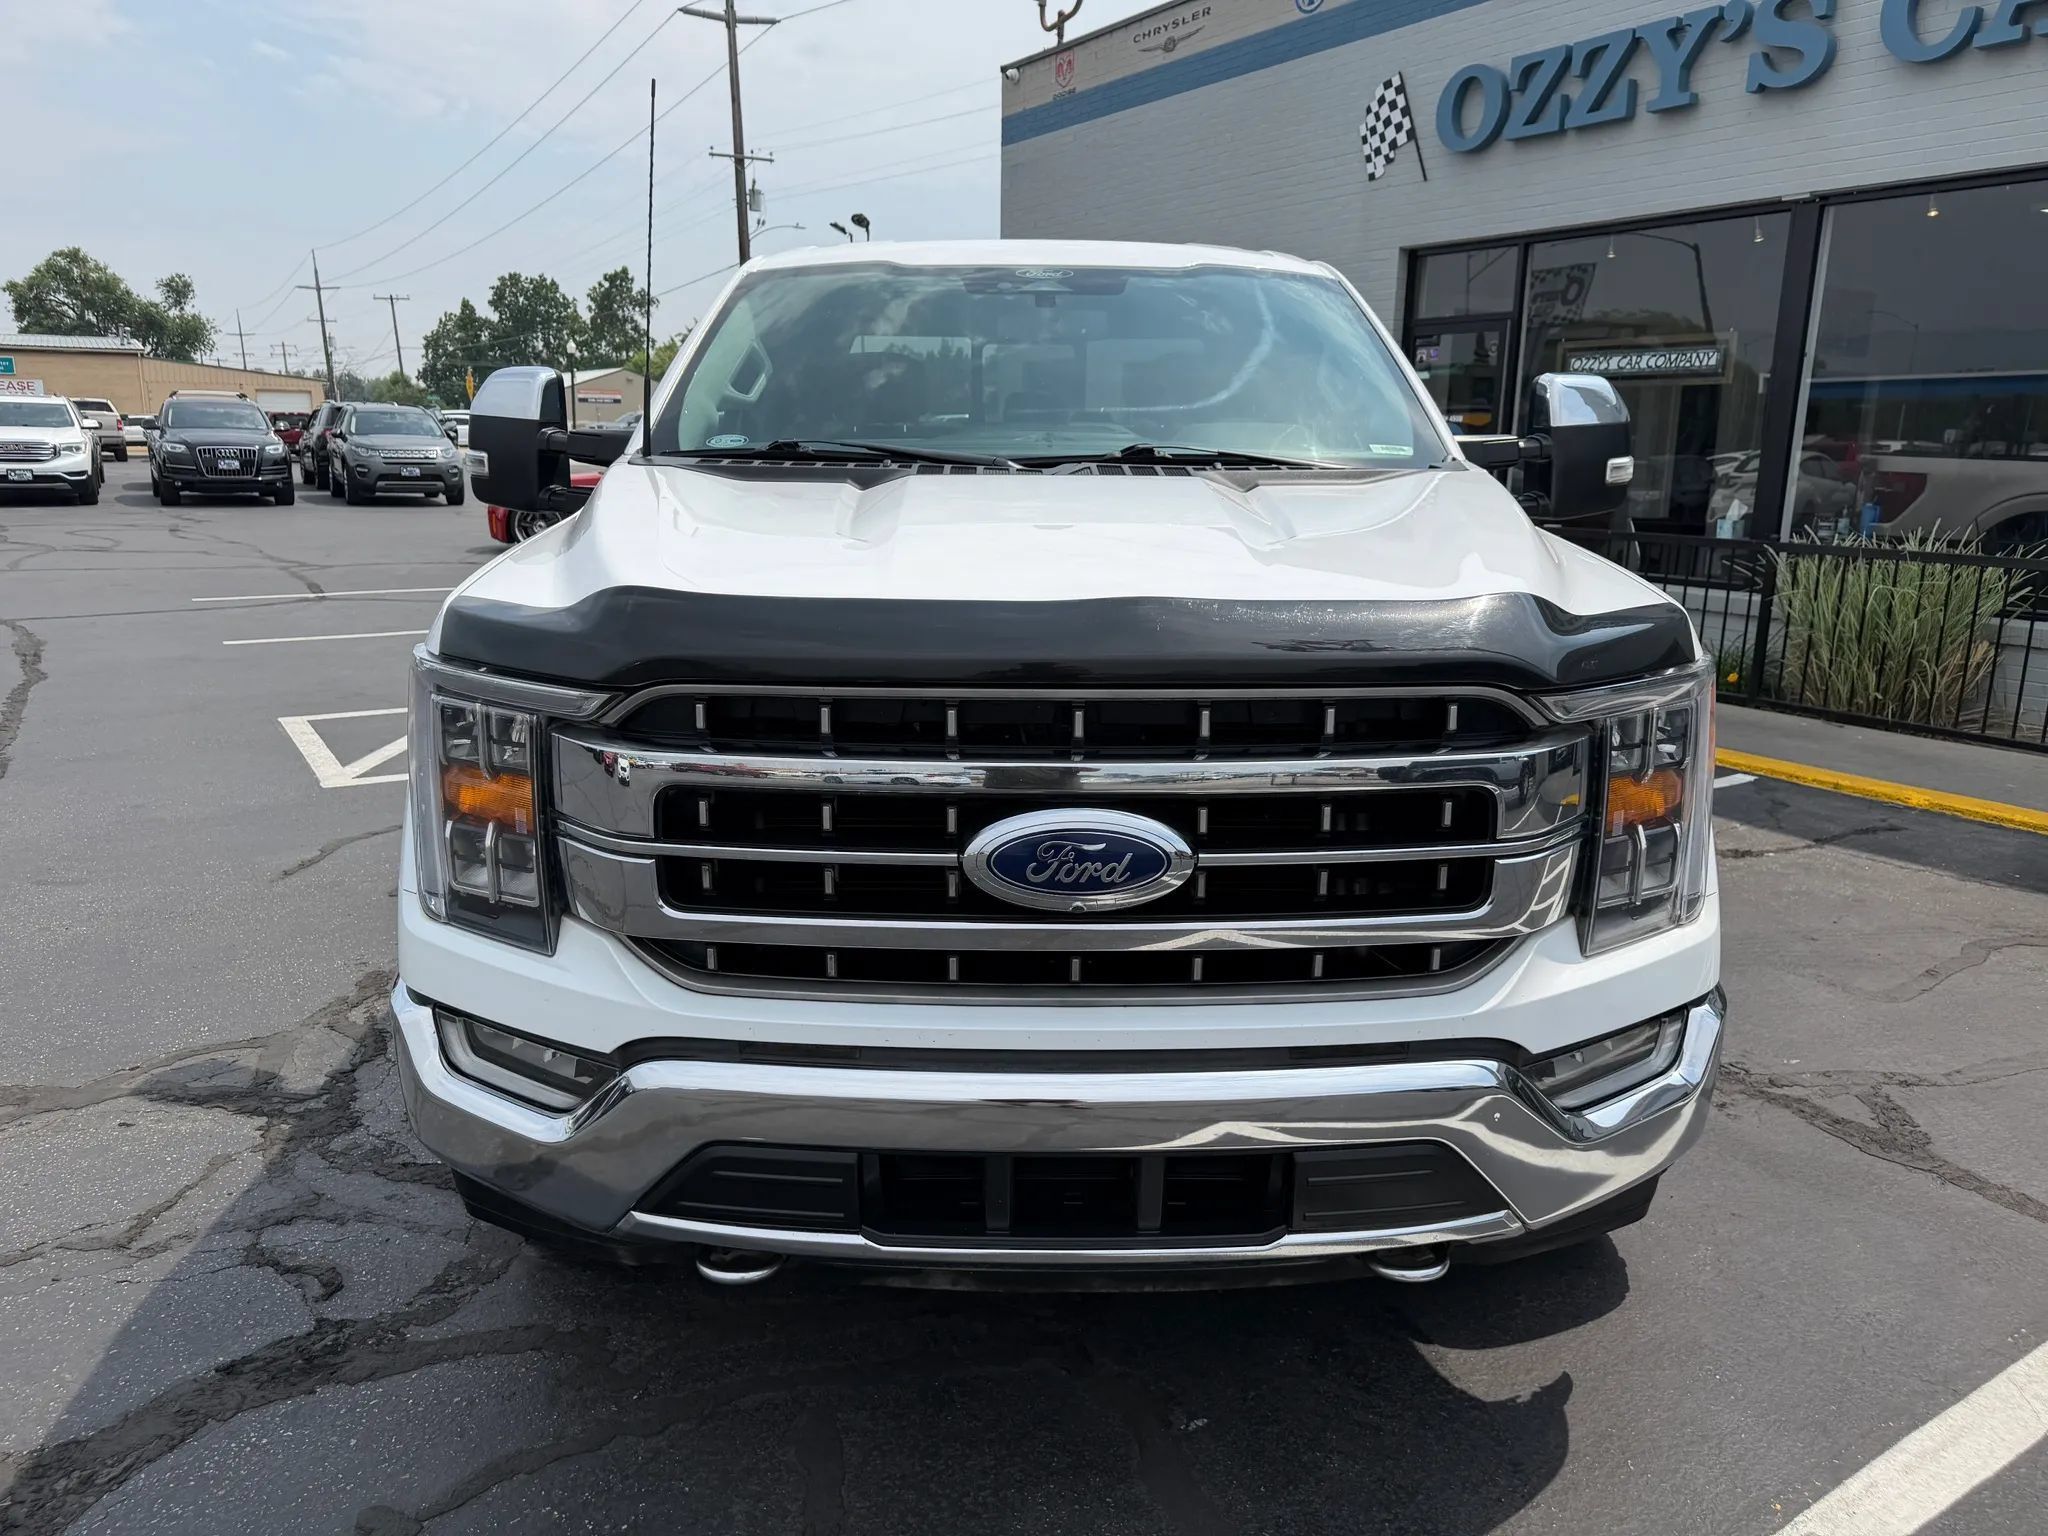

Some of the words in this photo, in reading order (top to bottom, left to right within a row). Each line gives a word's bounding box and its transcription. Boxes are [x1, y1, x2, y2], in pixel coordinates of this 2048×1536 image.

[1133, 6, 1211, 43] CHRYSLER
[1435, 0, 1836, 153] OZZY'S
[1571, 356, 1612, 371] OZZY'S
[1617, 355, 1641, 369] CAR
[1646, 352, 1716, 368] COMPANY
[1025, 840, 1133, 884] Ford
